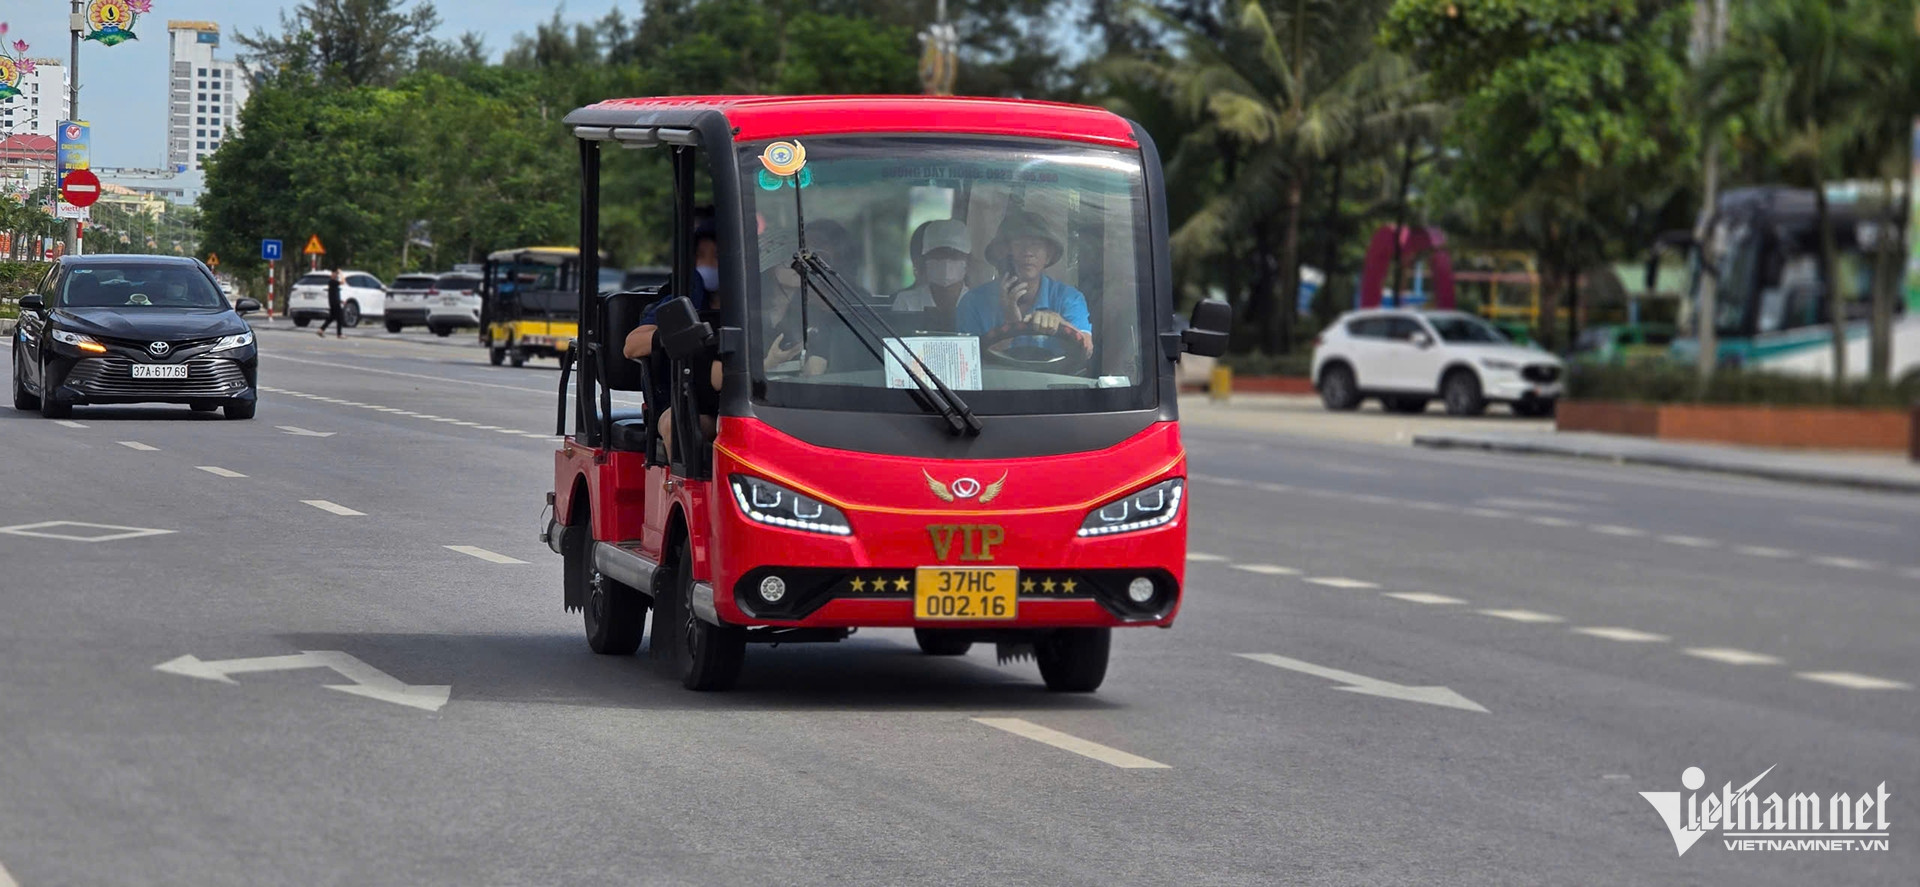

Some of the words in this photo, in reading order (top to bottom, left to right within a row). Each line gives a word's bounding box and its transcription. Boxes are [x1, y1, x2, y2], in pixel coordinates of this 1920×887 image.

[60, 204, 87, 212] viettl
[926, 524, 1005, 561] VIP
[938, 571, 996, 592] 37HC
[926, 596, 1006, 617] 002.16
